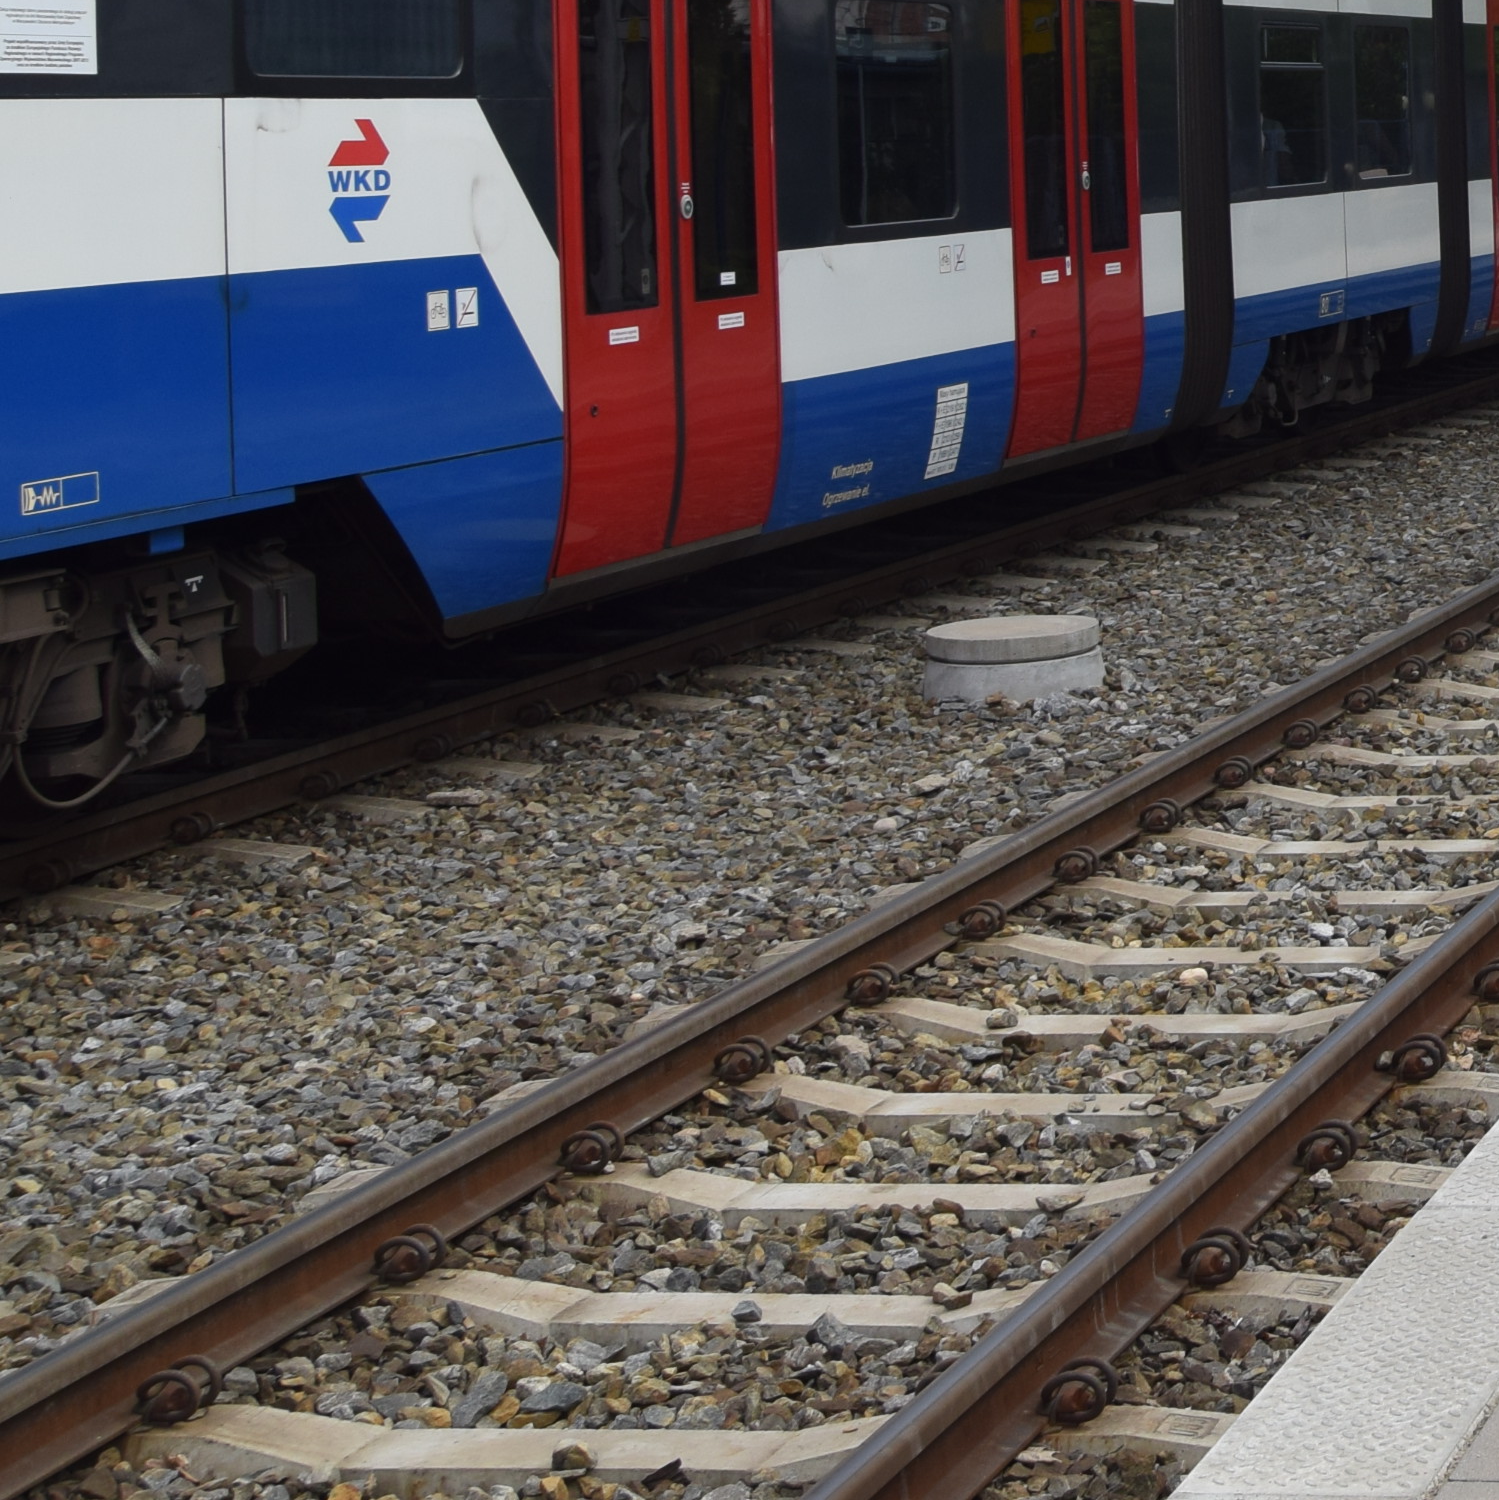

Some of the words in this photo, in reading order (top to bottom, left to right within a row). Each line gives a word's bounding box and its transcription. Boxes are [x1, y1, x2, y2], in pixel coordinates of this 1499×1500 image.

[328, 169, 391, 193] WKD
[832, 459, 873, 479] Klimatyzacja
[822, 486, 861, 508] Ogrzewanie
